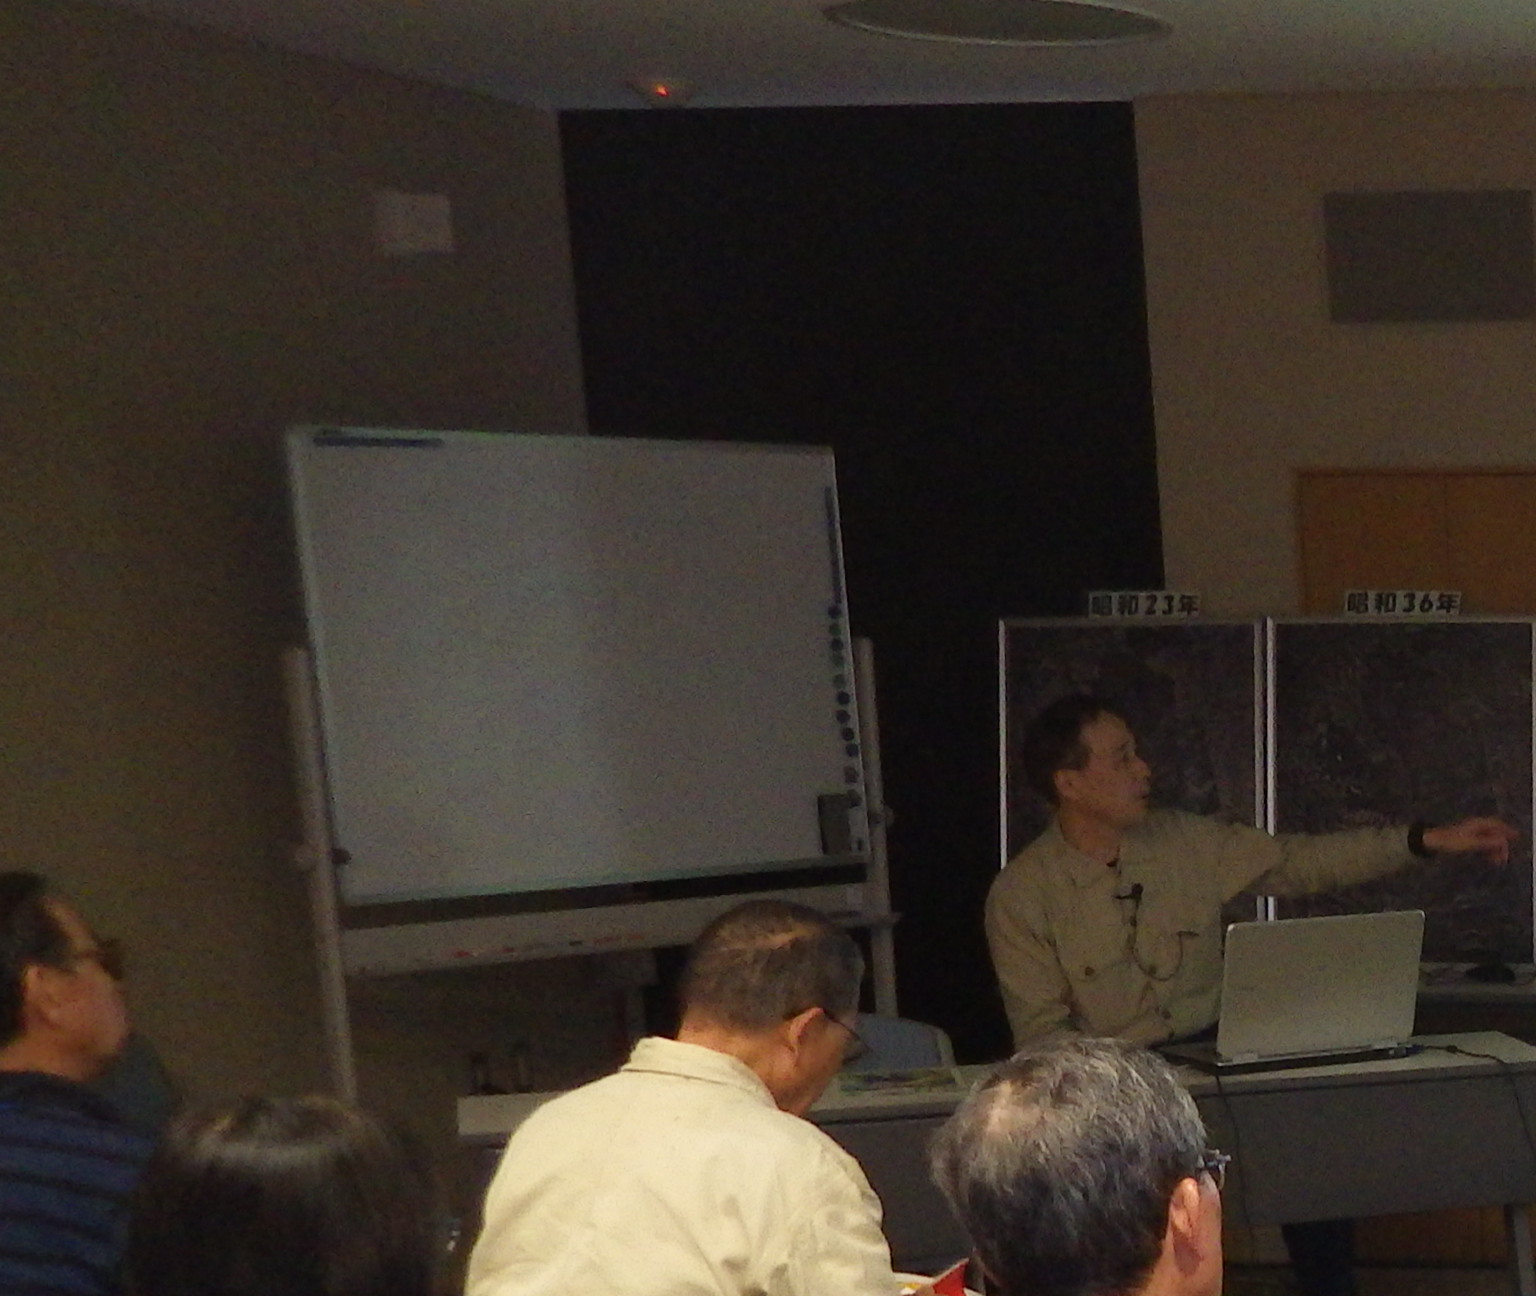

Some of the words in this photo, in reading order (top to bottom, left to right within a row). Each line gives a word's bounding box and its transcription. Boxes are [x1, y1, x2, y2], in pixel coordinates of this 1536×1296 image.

[1091, 594, 1199, 616] 昭和23年
[1347, 591, 1460, 614] 昭和36年
